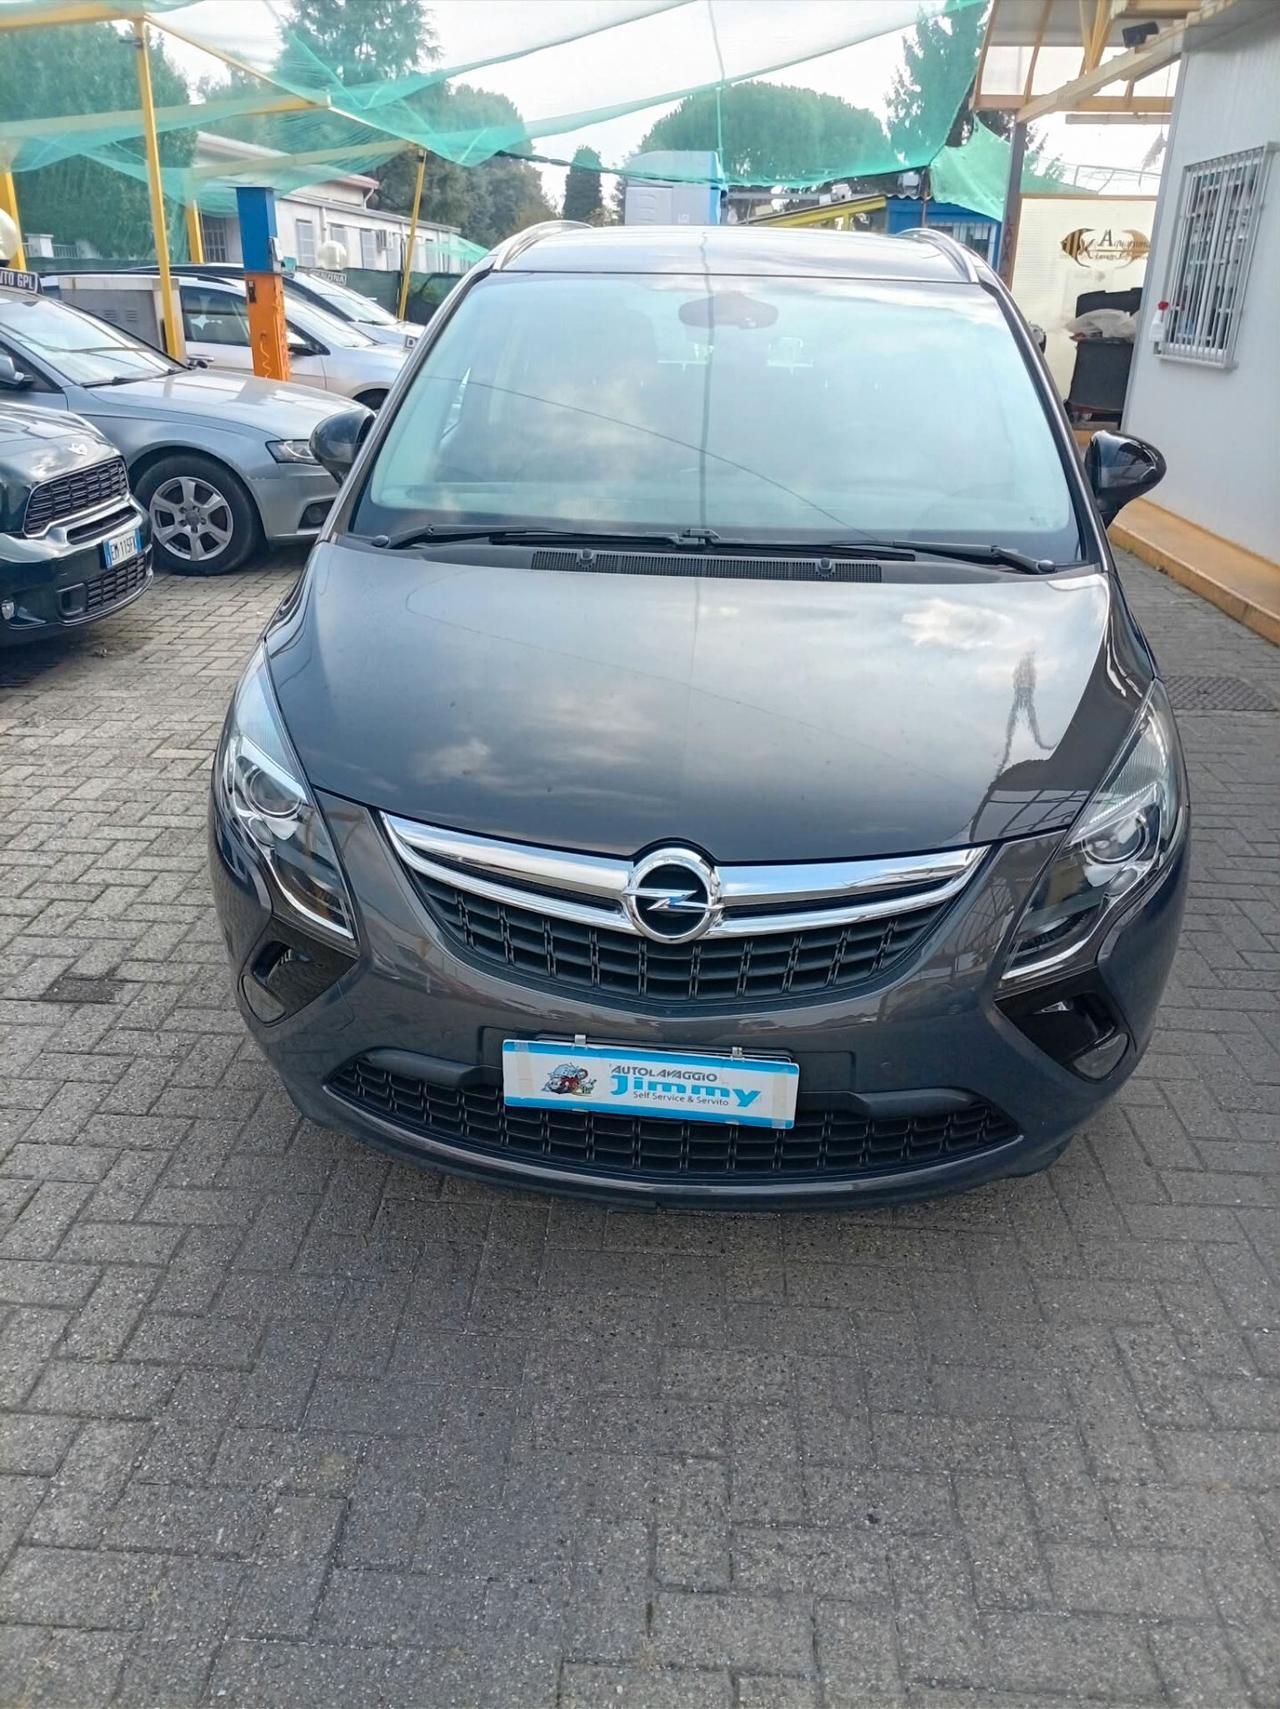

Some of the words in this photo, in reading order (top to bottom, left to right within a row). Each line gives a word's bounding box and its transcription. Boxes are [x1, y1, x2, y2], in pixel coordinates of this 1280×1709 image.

[17, 274, 34, 289] GPL
[611, 1065, 718, 1083] AUTOLAVAGGIO
[610, 1075, 762, 1107] Jimmy
[633, 1091, 650, 1099] Self
[652, 1093, 685, 1103] Service
[696, 1097, 729, 1106] Servito
